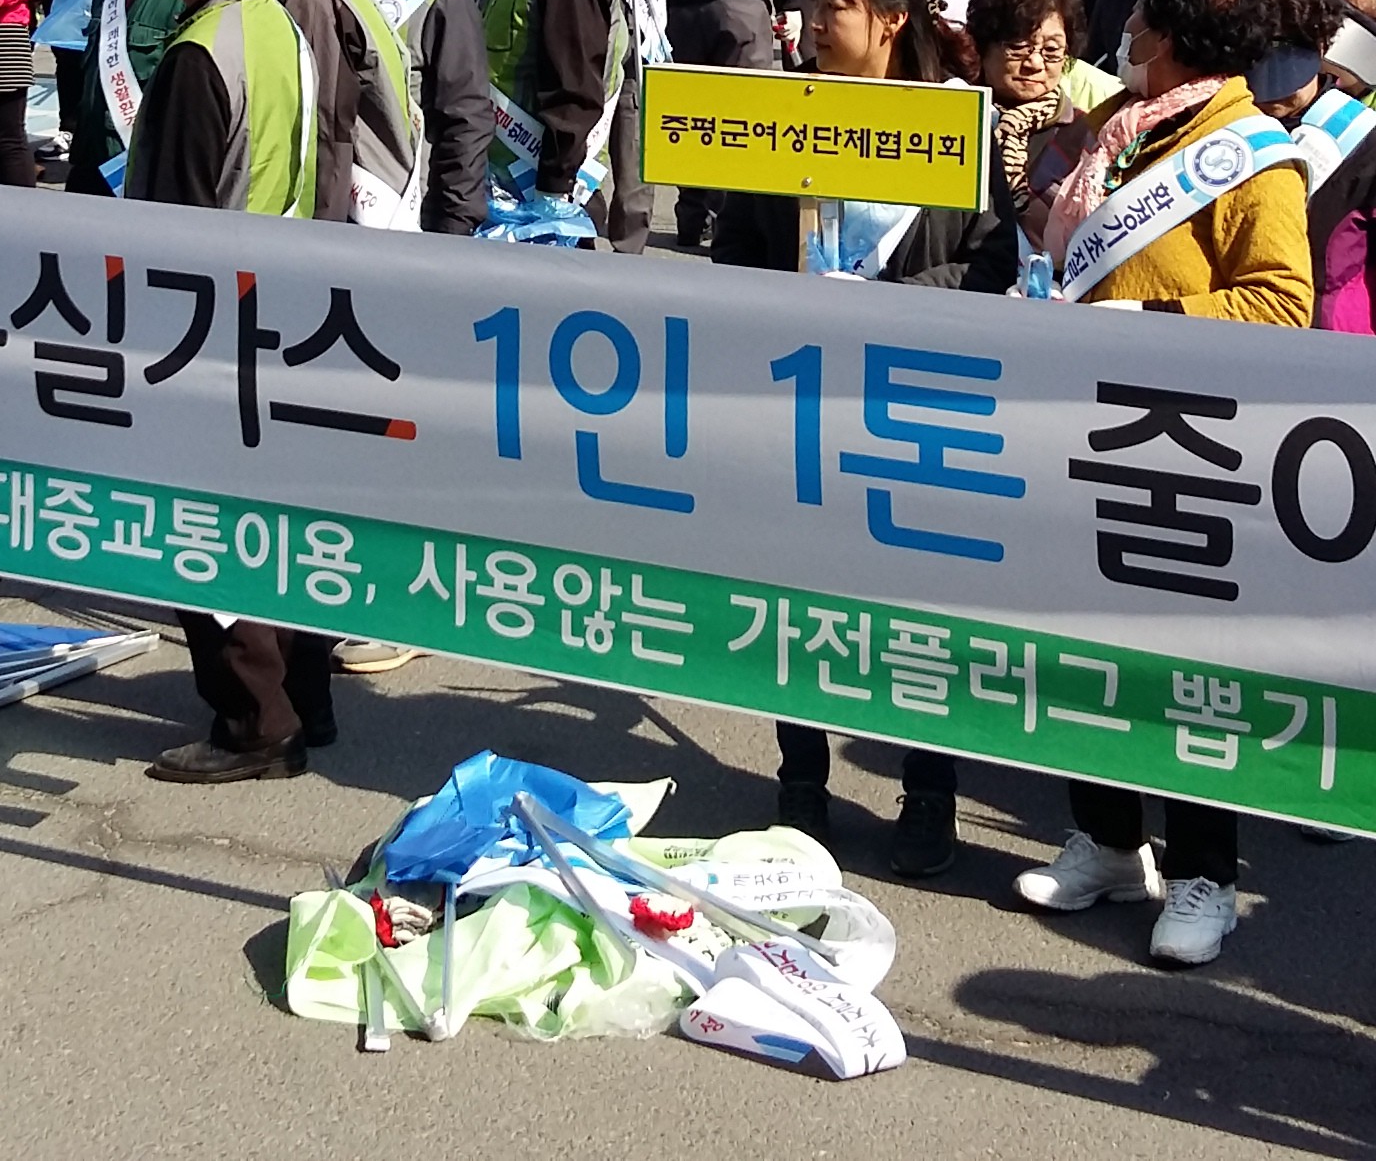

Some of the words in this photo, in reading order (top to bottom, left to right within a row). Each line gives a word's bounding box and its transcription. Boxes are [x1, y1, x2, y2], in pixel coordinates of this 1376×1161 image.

[659, 113, 967, 166] 증평군여성단체협의회
[473, 306, 695, 514] 1인
[769, 343, 1027, 563] 1톤
[408, 541, 694, 667] 사용않는
[728, 593, 1132, 733] 가전플러그
[1165, 669, 1337, 791] 뽑기
